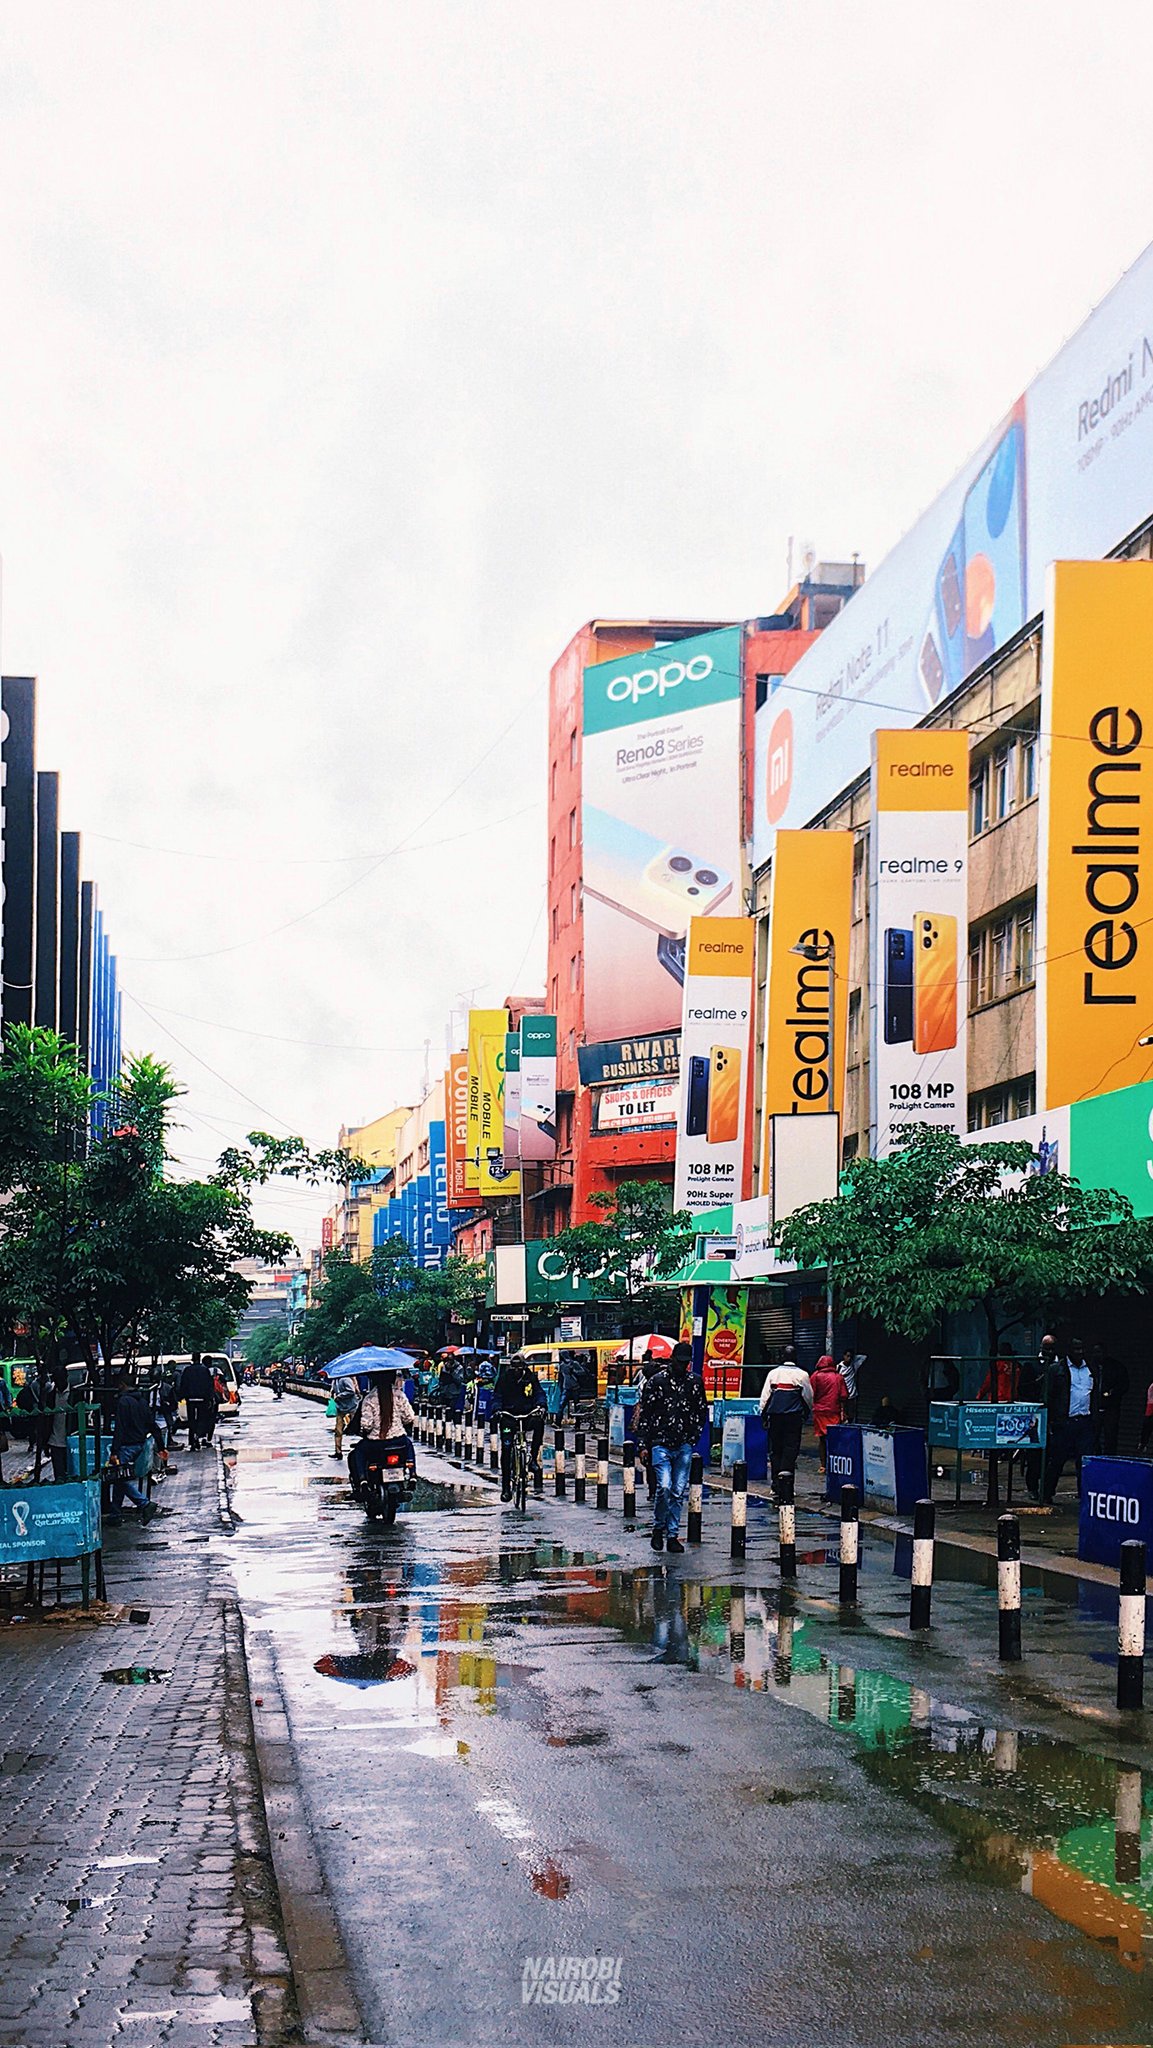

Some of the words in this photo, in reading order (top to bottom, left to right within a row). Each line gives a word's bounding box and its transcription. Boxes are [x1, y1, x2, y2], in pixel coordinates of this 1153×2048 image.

[1078, 353, 1134, 441] Redmi
[846, 644, 872, 690] Note
[606, 654, 713, 704] oppo
[616, 739, 665, 766] Reno8
[667, 735, 704, 754] Series
[889, 761, 954, 778] realme
[1071, 706, 1142, 1005] realme
[880, 856, 948, 874] realme
[954, 859, 963, 873] 9
[698, 942, 744, 954] realme
[688, 1008, 737, 1020] realme
[741, 1010, 748, 1020] 9
[527, 1032, 551, 1040] oppo
[602, 1059, 659, 1078] BUSINESS
[470, 1075, 479, 1122] MOBILE
[604, 1090, 631, 1105] SHOPS
[632, 1090, 638, 1100] &
[640, 1085, 673, 1100] OFFICES
[889, 1083, 922, 1100] 108
[927, 1083, 955, 1099] MP
[482, 1091, 491, 1140] MOBILE
[618, 1103, 633, 1116] TO
[637, 1100, 656, 1114] LET
[889, 1102, 922, 1112] ProLight
[923, 1102, 955, 1110] Camera
[455, 1161, 464, 1194] MOBILE
[688, 1163, 711, 1175] 108
[714, 1163, 735, 1175] MP
[686, 1190, 708, 1198] 90Hz
[709, 1190, 734, 1199] Super
[829, 1455, 853, 1476] TECNO
[47, 1511, 70, 1519] WORLD
[1087, 1491, 1140, 1525] TECNO
[12, 1540, 46, 1548] SPONSOR
